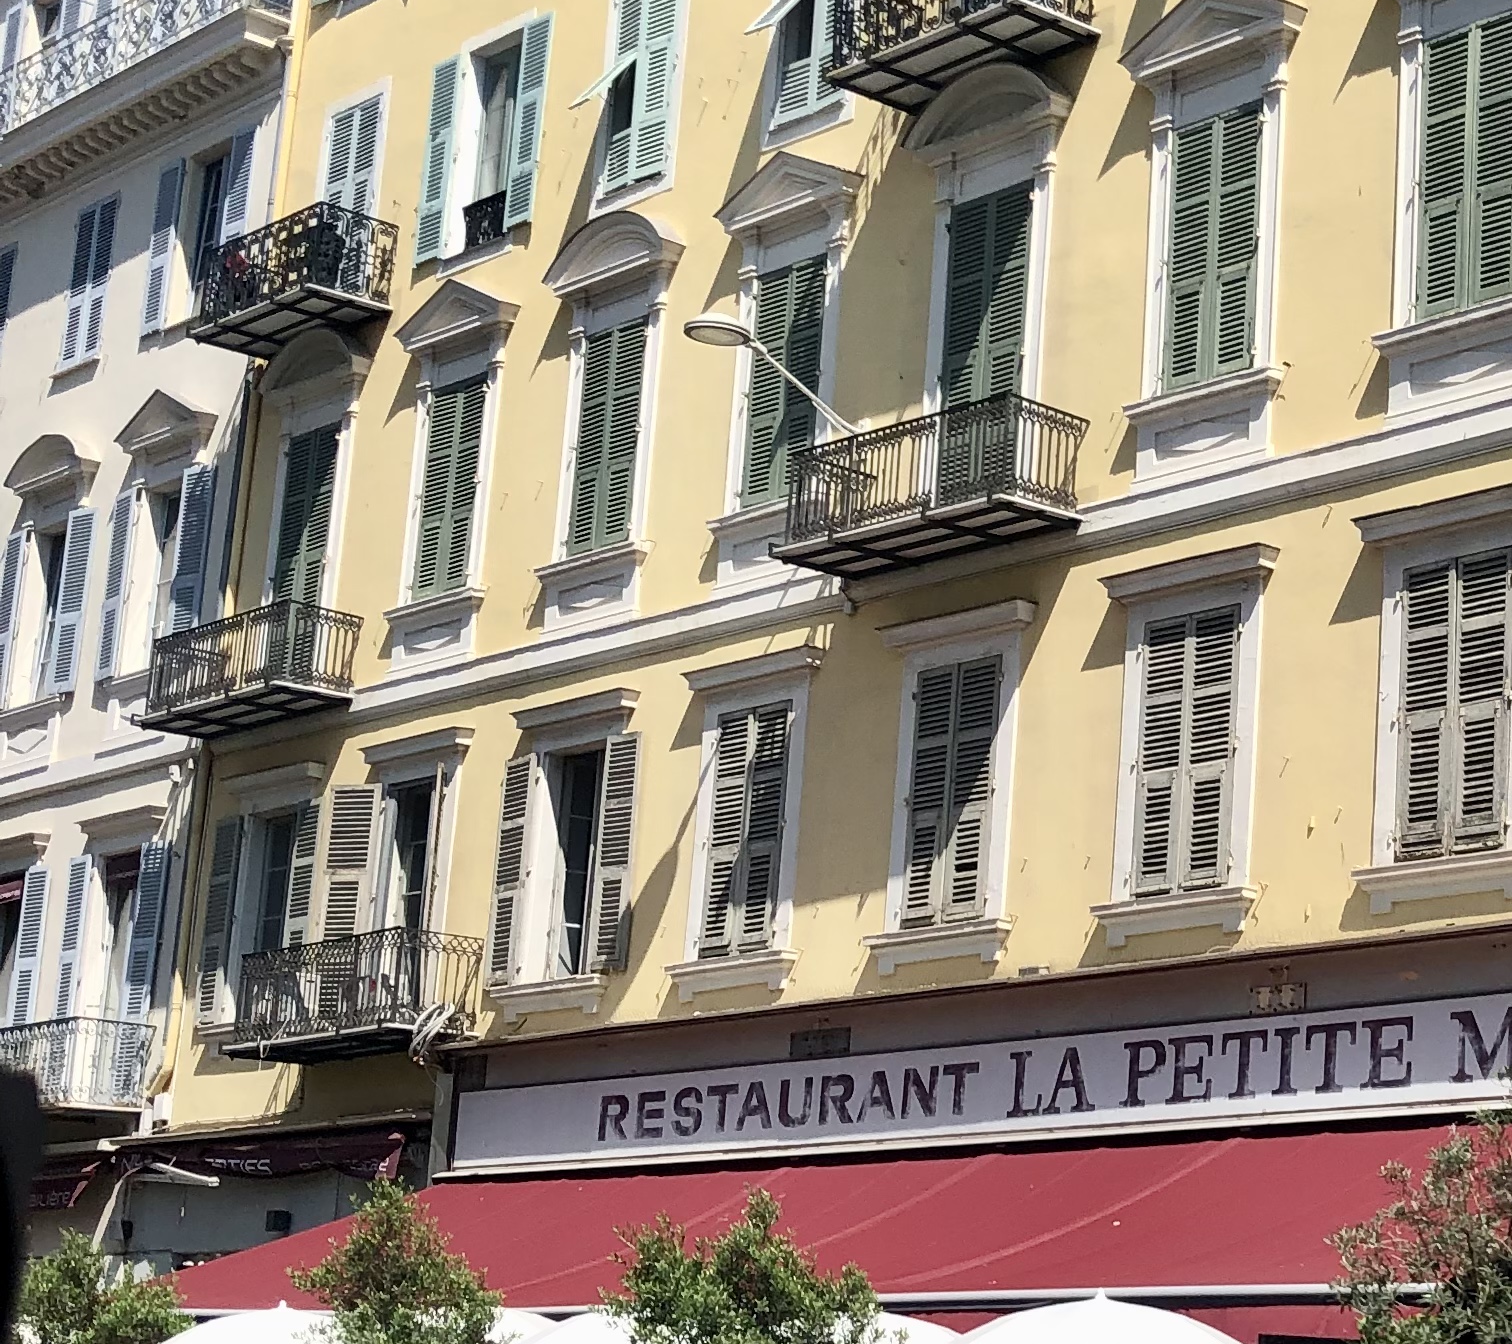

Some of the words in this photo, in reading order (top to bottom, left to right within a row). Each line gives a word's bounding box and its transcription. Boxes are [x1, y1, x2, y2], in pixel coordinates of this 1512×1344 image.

[598, 1061, 980, 1142] RESTAURANT
[1007, 1046, 1096, 1119] LA
[1118, 1015, 1414, 1108] PETITE
